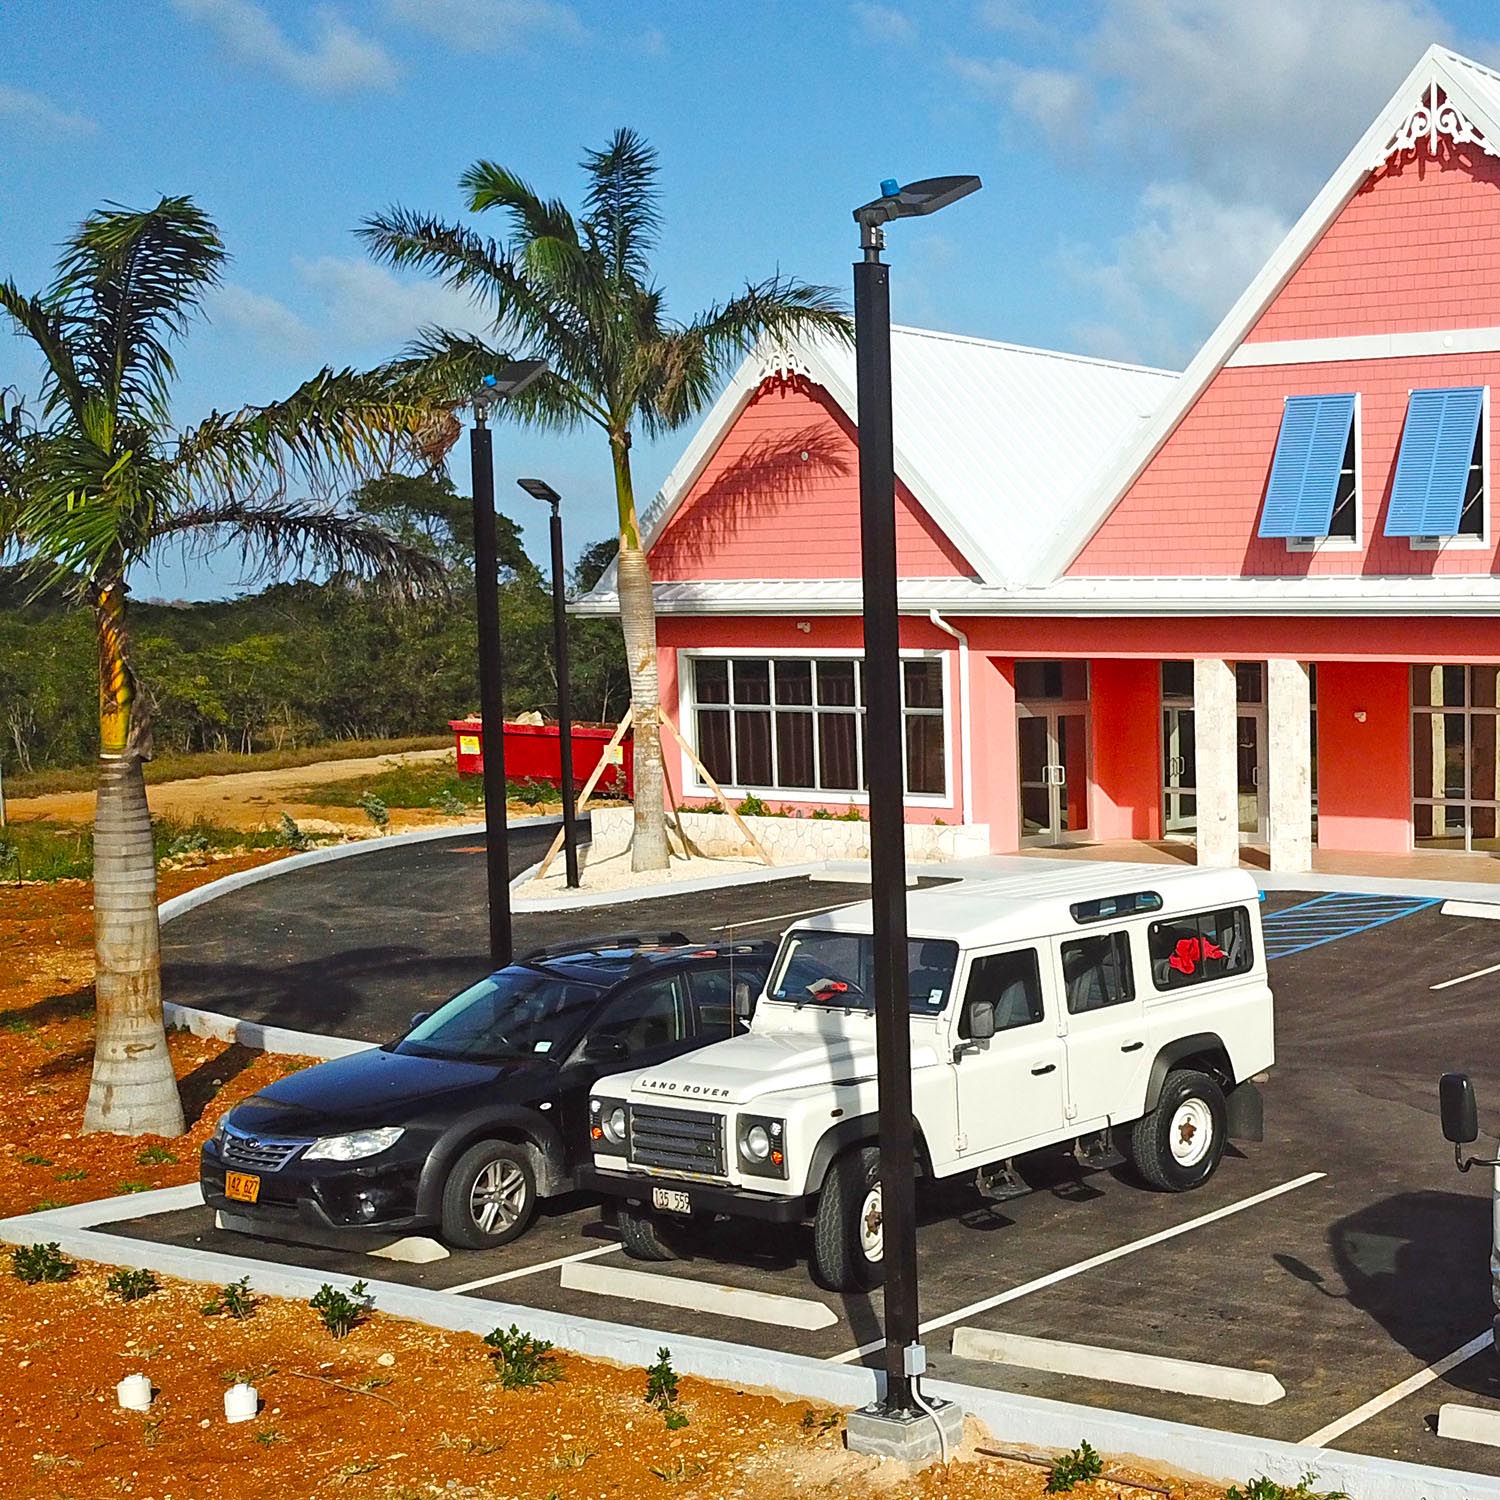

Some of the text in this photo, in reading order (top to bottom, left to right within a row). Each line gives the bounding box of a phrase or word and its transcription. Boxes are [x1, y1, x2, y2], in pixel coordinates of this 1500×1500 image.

[642, 1080, 730, 1097] LAND ROVER
[675, 1193, 690, 1209] 559
